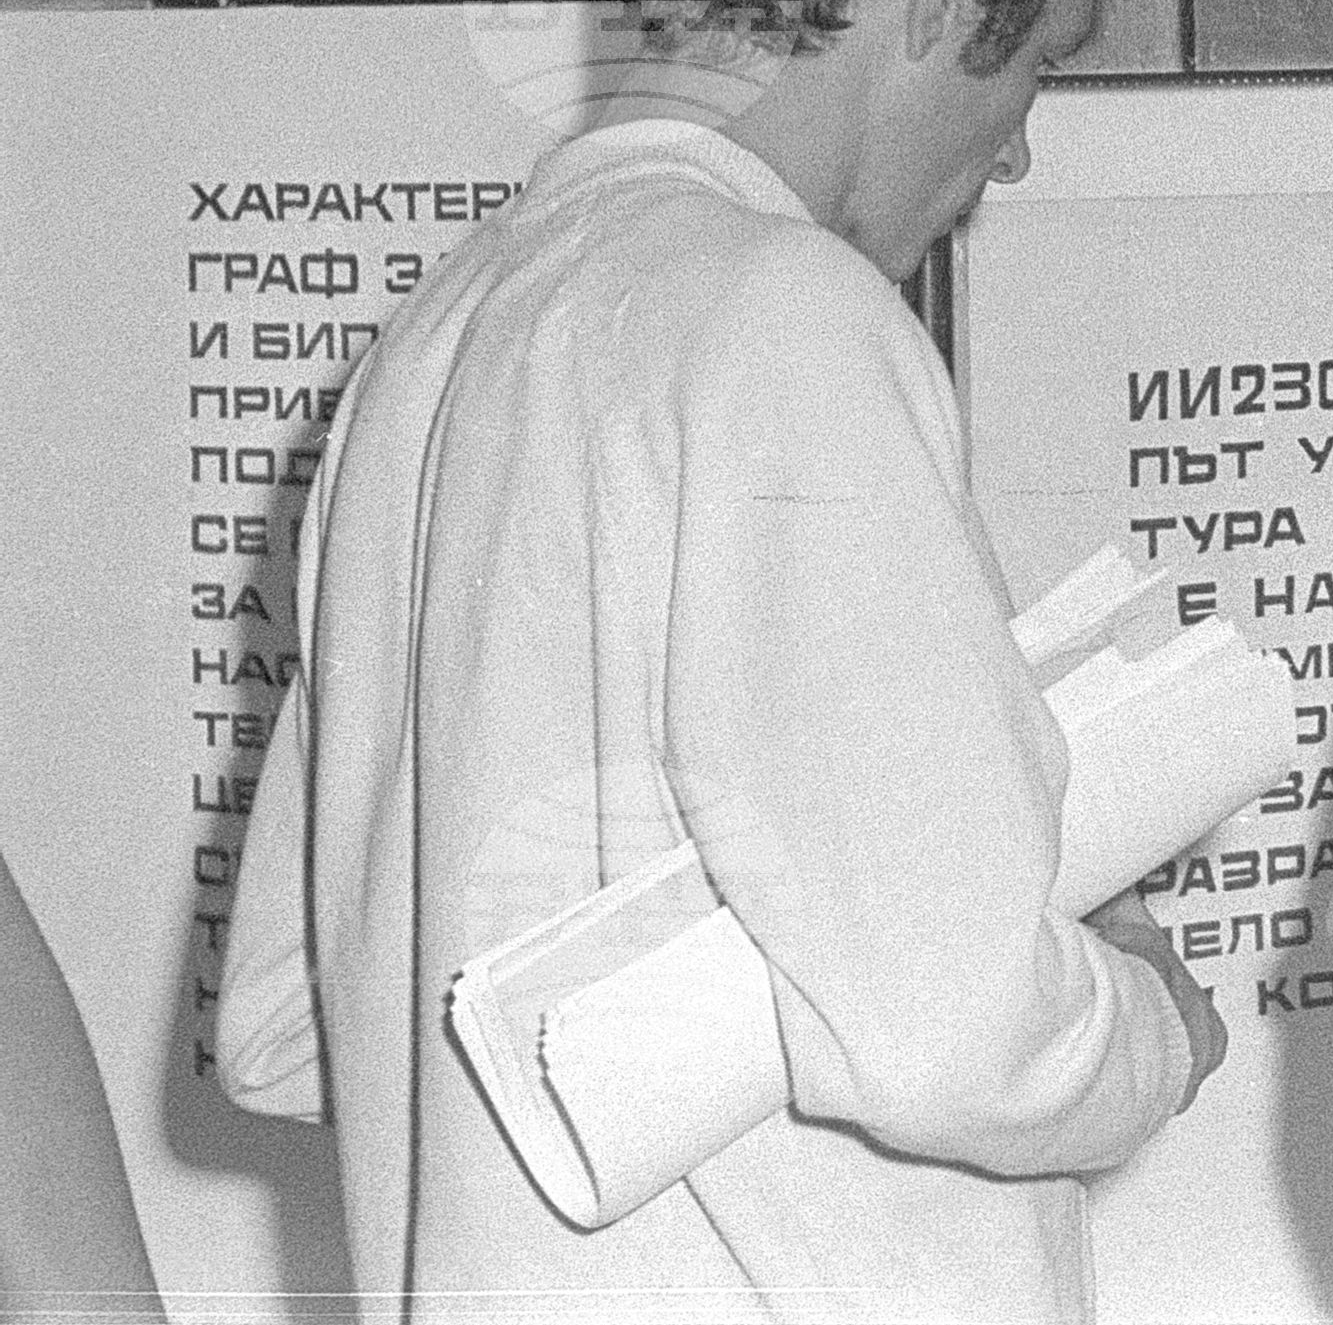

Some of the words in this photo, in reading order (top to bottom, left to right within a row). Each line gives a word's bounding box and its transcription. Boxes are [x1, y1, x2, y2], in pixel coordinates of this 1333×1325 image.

[188, 182, 522, 222] ХАРАКТЕР
[188, 247, 359, 299] ГРАФ
[189, 321, 228, 360] И
[1129, 440, 1265, 488] ПЪТ
[191, 514, 268, 556] СЕ
[1130, 507, 1307, 560] ТУРА
[191, 583, 271, 622] ЗА
[1160, 907, 1314, 962] ЕЛО
